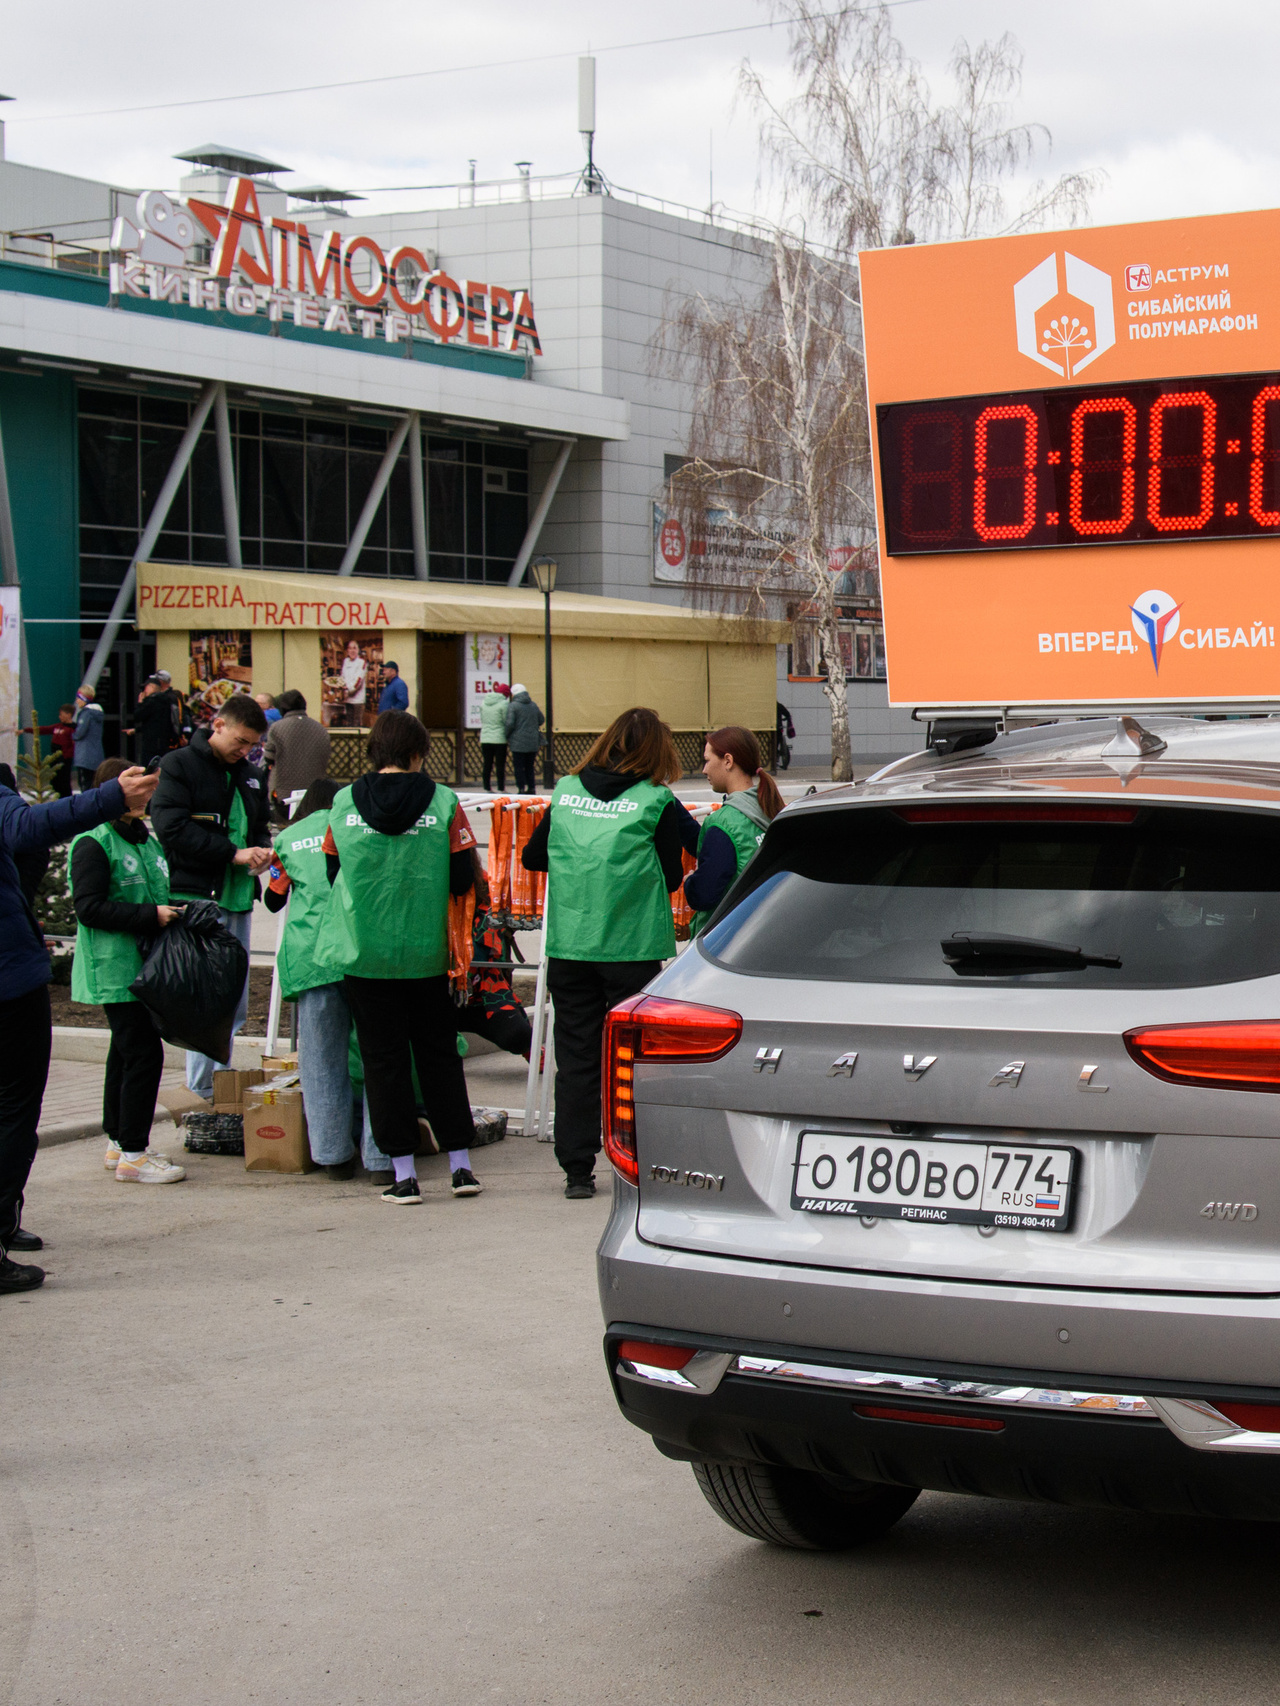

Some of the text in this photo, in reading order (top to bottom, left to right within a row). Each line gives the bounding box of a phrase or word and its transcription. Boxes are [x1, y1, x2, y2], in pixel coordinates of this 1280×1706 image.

[184, 177, 542, 356] АТМОСФЕРА
[1155, 263, 1230, 285] АСТРУМ
[110, 262, 411, 343] КИНОТЕАТР
[1127, 290, 1231, 317] СИБАЙСКИЙ
[1128, 314, 1258, 340] ПОЛУМАРАФОН
[664, 537, 681, 557] 29
[139, 585, 246, 609] PIZZERIA
[247, 602, 390, 626] TRATTORIA
[1038, 621, 1276, 654] ВПЕРЕД, СИБАЙ!
[558, 793, 639, 813] ВОЛОНТЁР
[752, 1047, 1110, 1094] HAVAL
[648, 1164, 725, 1192] JOLION
[801, 1199, 858, 1214] HAVAL
[1001, 1192, 1034, 1207] RUS
[1200, 1201, 1259, 1222] 4WD
[901, 1206, 948, 1220] РЕГИНАС
[994, 1214, 1056, 1228] (3519) 490-414
